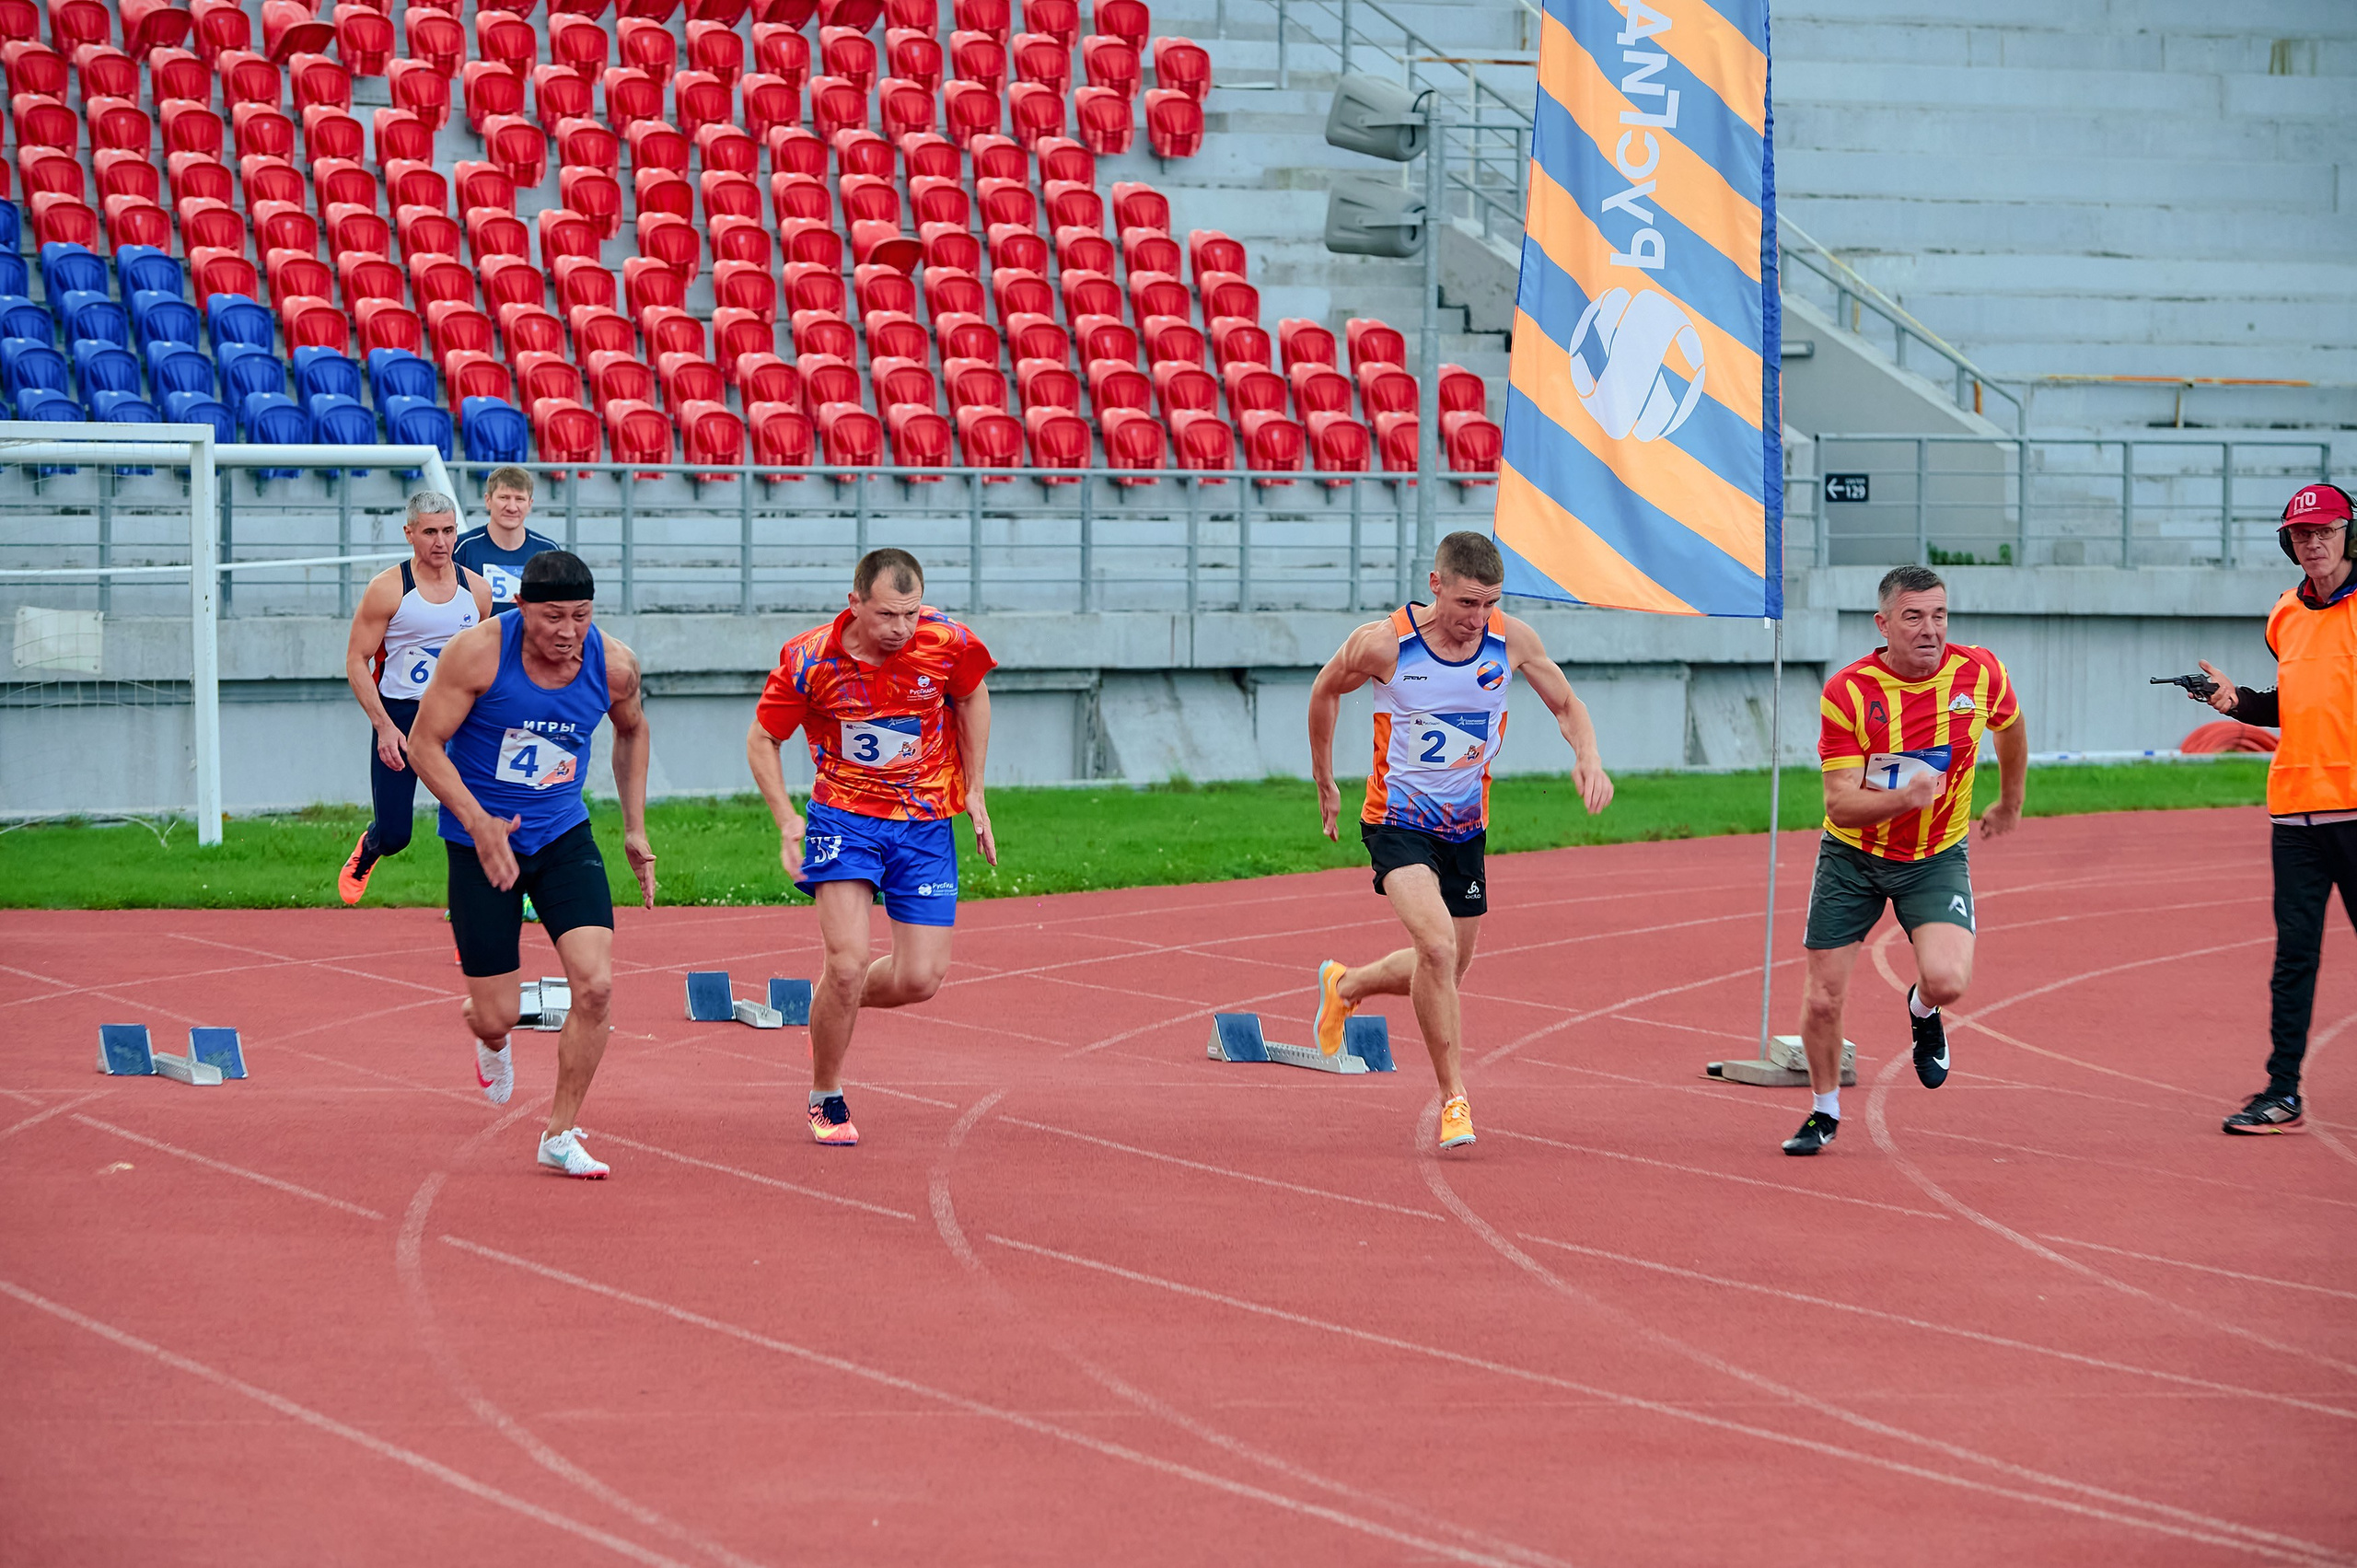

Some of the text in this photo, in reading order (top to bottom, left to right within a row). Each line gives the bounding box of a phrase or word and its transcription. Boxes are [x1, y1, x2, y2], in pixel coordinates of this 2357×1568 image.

[492, 576, 507, 598] 5
[410, 659, 429, 684] 6
[523, 720, 575, 733] ИГРЫ
[853, 733, 880, 762] 3
[1420, 729, 1446, 763] 2
[509, 744, 540, 778] 4
[1881, 763, 1900, 790] 1
